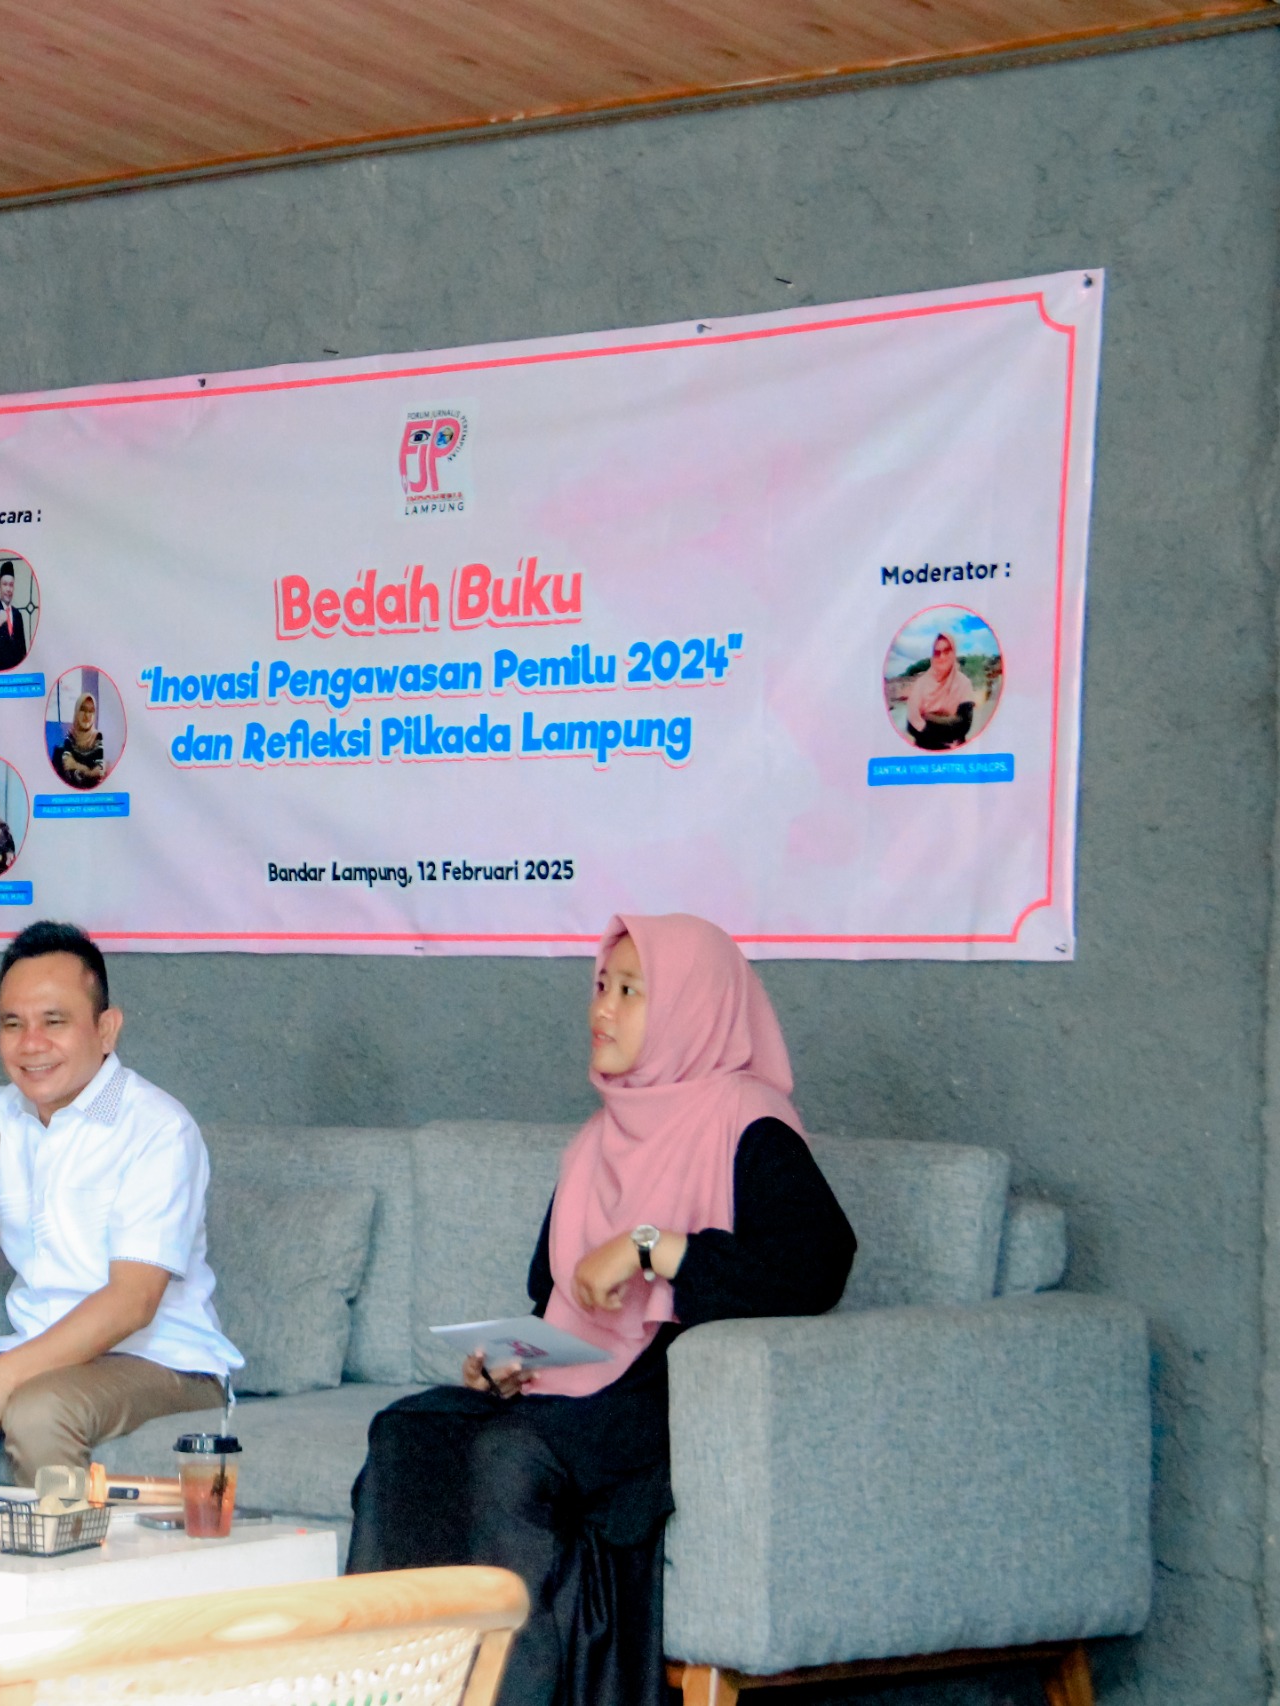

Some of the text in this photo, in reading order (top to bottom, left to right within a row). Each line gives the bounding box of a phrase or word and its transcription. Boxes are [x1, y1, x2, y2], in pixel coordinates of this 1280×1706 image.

[407, 411, 430, 420] FORUM
[430, 409, 461, 419] JURNALIS
[405, 502, 465, 515] LAMPUNG
[881, 562, 998, 585] Moderator
[276, 557, 582, 638] Bedah Buku
[268, 661, 482, 709] Pengawasan
[494, 644, 616, 689] Pemilu
[171, 712, 692, 763] dan Refleksi Pilkada Lampung
[873, 765, 908, 776] SANTIKA
[268, 859, 574, 888] Bandar Lampung, 12 Februari 2025
